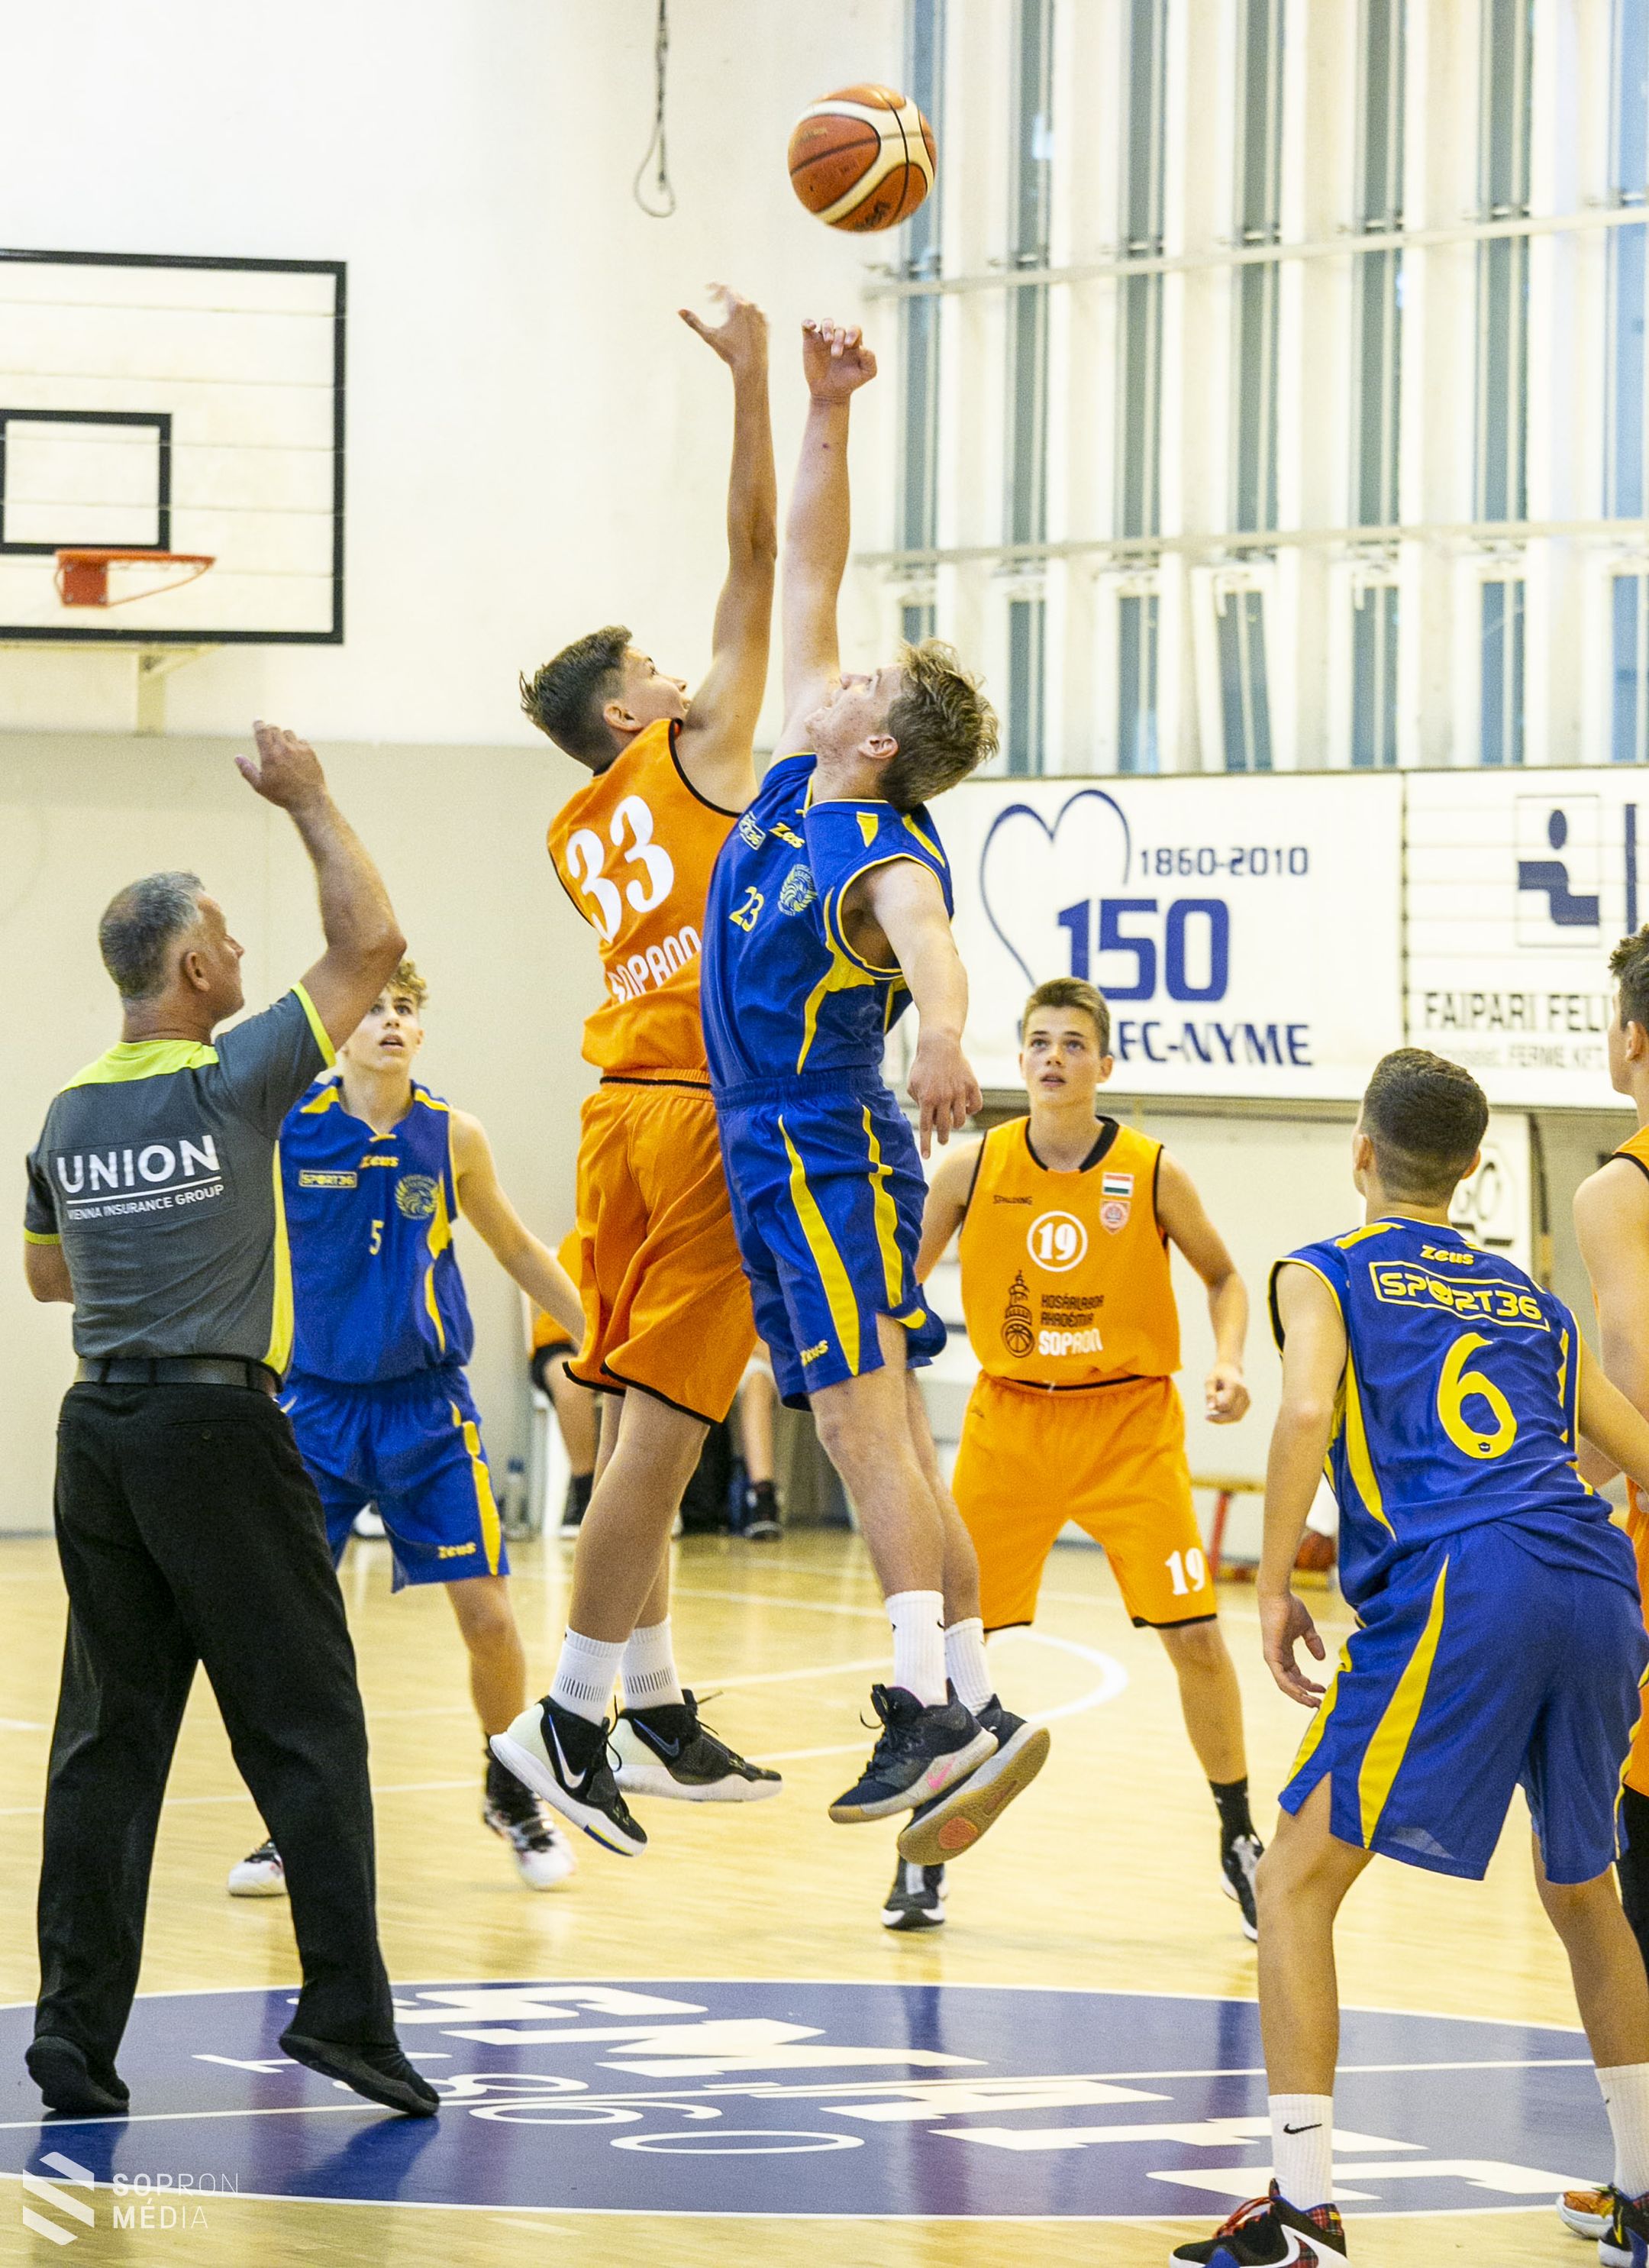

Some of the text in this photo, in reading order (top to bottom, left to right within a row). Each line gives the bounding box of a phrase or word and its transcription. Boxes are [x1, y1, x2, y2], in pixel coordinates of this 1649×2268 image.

[566, 795, 673, 944] 33
[1141, 847, 1308, 876] 1860-2010
[729, 886, 764, 932] 23
[1058, 899, 1228, 1000] 150
[1425, 991, 1609, 1032] FAIPARI FEL
[56, 1134, 221, 1194] UNION
[103, 1197, 174, 1216] INSURANCE
[174, 1184, 224, 1205] GROUP
[369, 1220, 384, 1255] 5
[1038, 1222, 1077, 1261] 19
[1379, 1271, 1543, 1320] SPORT36
[1038, 1328, 1103, 1356] SOPRON
[1437, 1332, 1518, 1459] 6
[1164, 1547, 1205, 1596] 19
